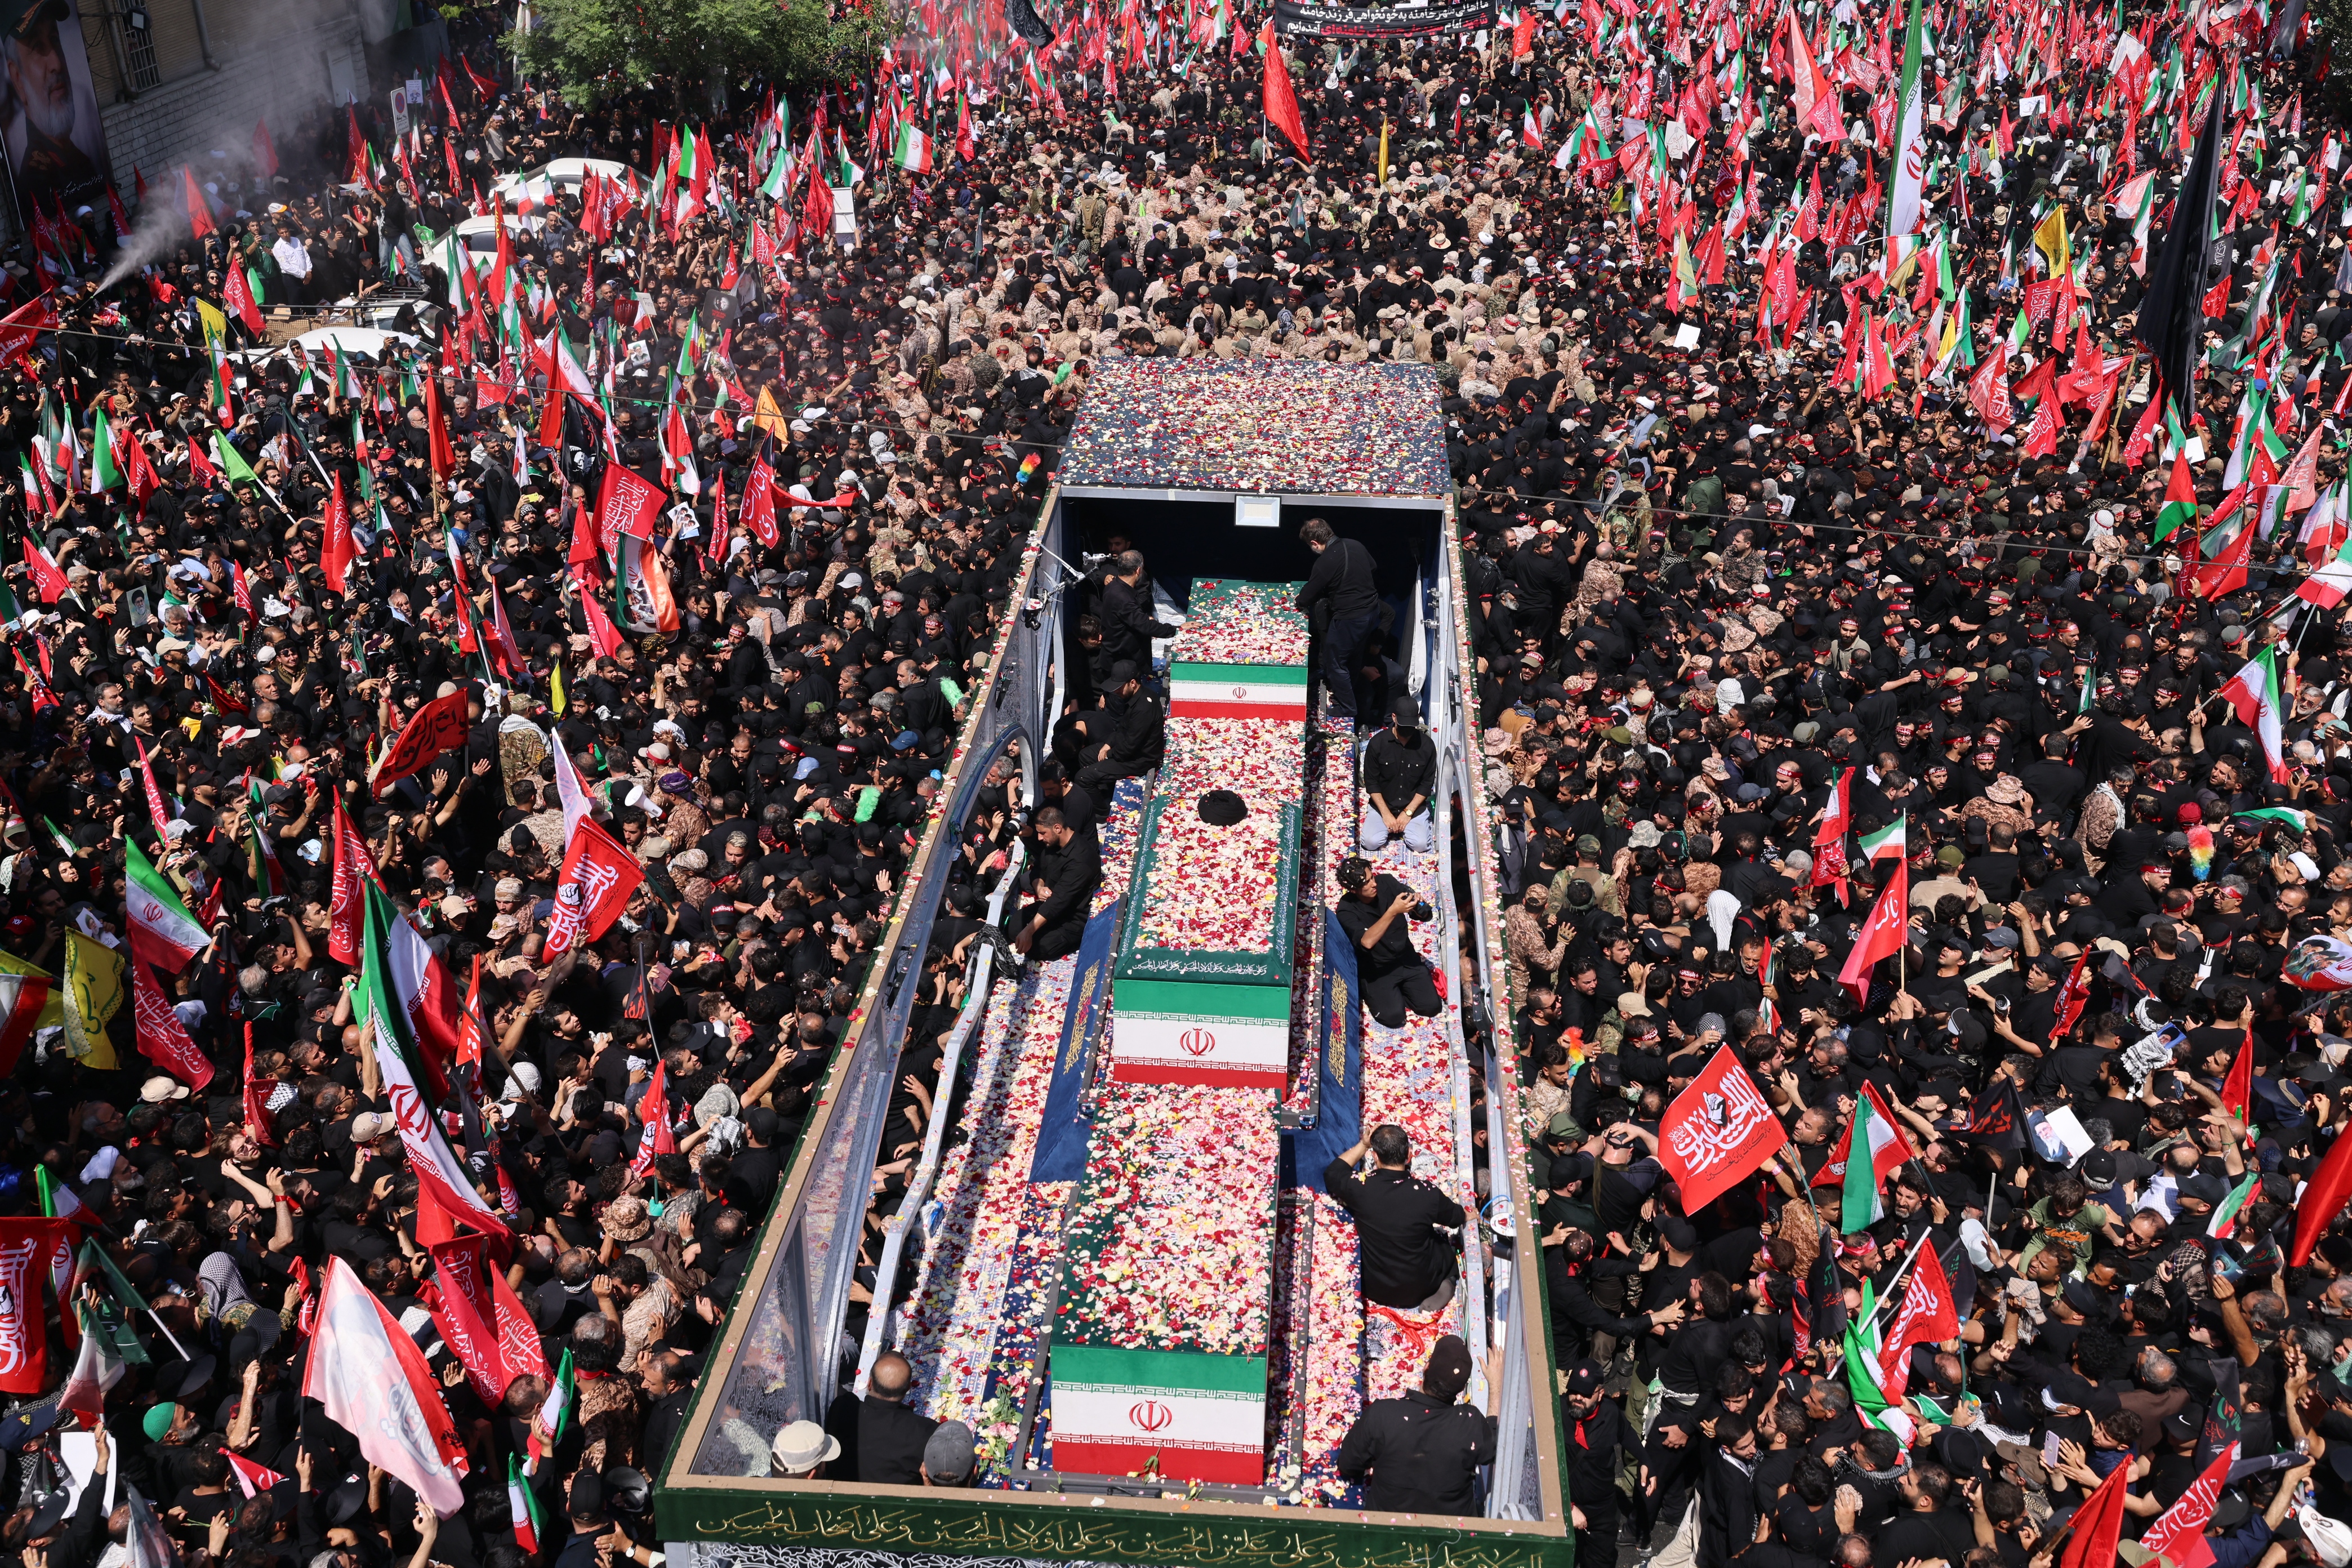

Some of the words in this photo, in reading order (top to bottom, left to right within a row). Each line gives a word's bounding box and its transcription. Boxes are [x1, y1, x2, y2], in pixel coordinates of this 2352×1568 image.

[1456, 2, 1478, 17] اهالی
[1480, 0, 1489, 8] ما
[1300, 6, 1326, 17] خامنه
[1326, 8, 1353, 22] فرزند
[1353, 8, 1398, 23] خونخواهی
[1398, 11, 1407, 21] به
[1408, 8, 1437, 19] خامنه
[1436, 6, 1455, 20] شهر
[1445, 18, 1462, 33] امام
[1463, 12, 1488, 29] شهید
